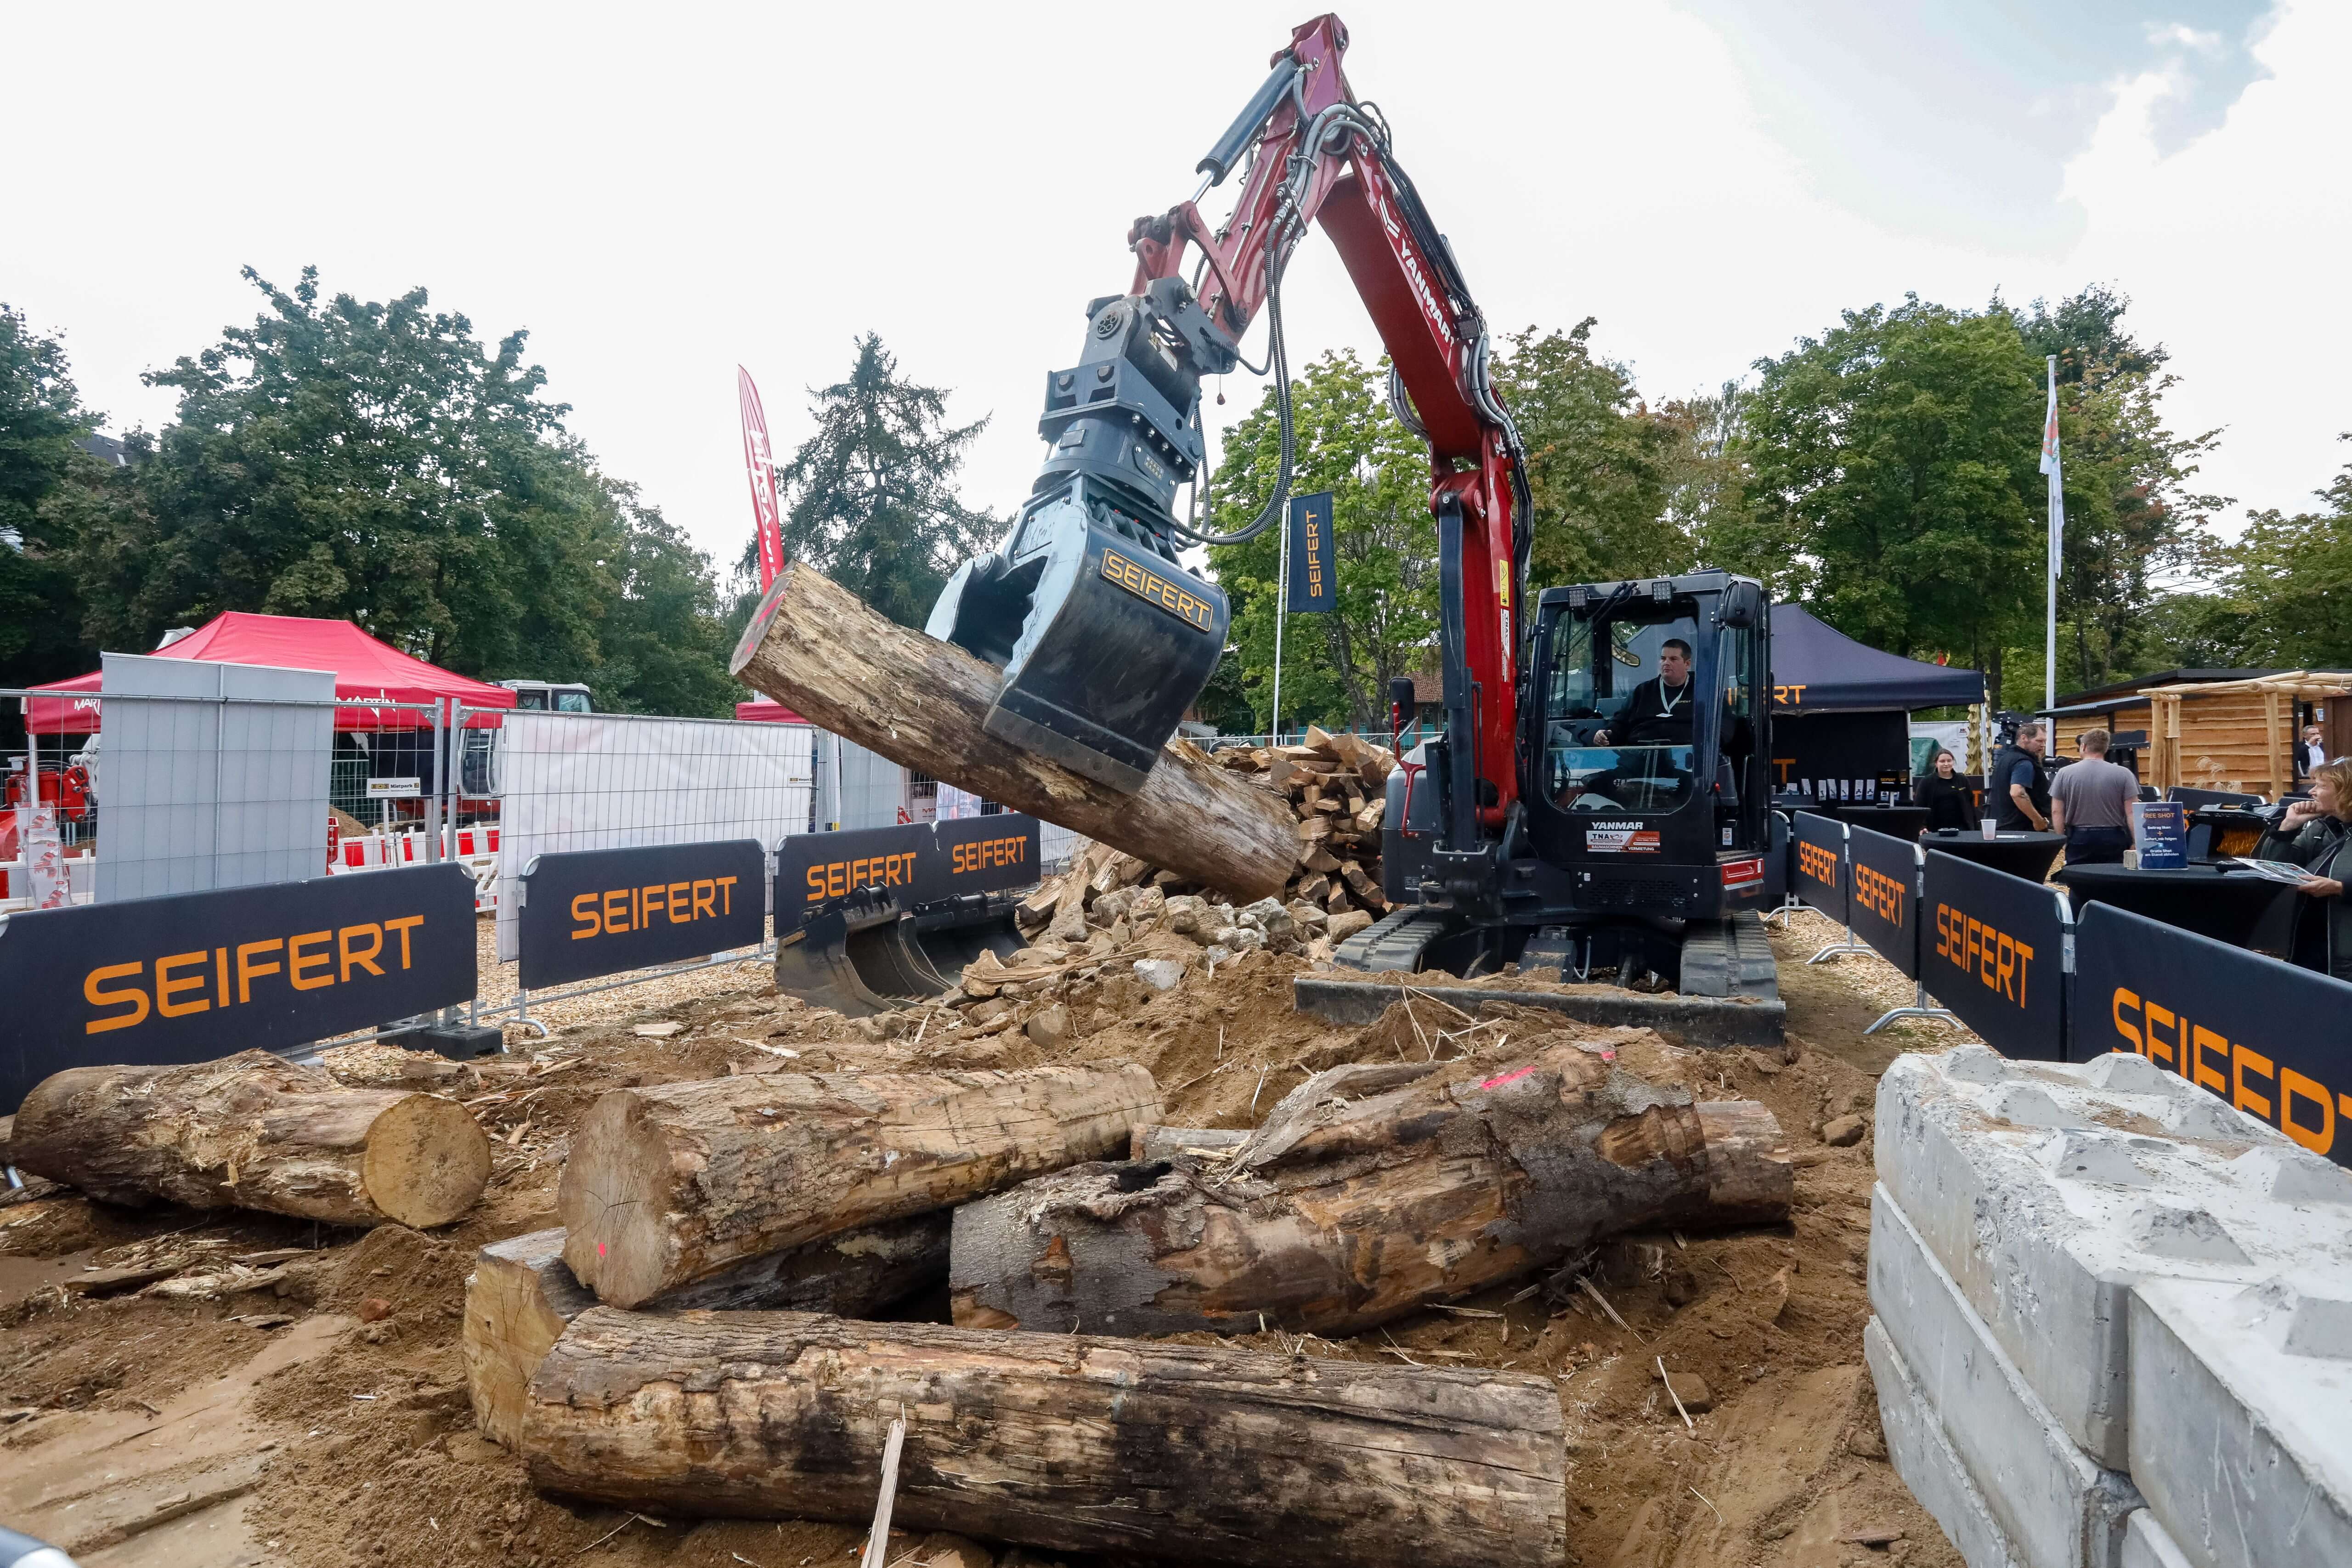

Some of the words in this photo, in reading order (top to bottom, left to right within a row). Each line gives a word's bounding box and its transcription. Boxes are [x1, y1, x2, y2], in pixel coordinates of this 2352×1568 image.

[1401, 238, 1451, 343] YANMAR
[1306, 510, 1322, 597] SEIFERT
[1106, 555, 1210, 623] SEIFERT
[807, 852, 916, 901] SEIFERT
[952, 836, 1027, 874] SEIFERT
[1799, 841, 1838, 888] SEIFERT
[571, 876, 737, 940] SEIFERT
[1855, 863, 1905, 928] SEIFERT
[84, 915, 424, 1035] SEIFERT
[1937, 903, 2034, 1009] SEIFERT
[2112, 987, 2352, 1155] SEIFER
